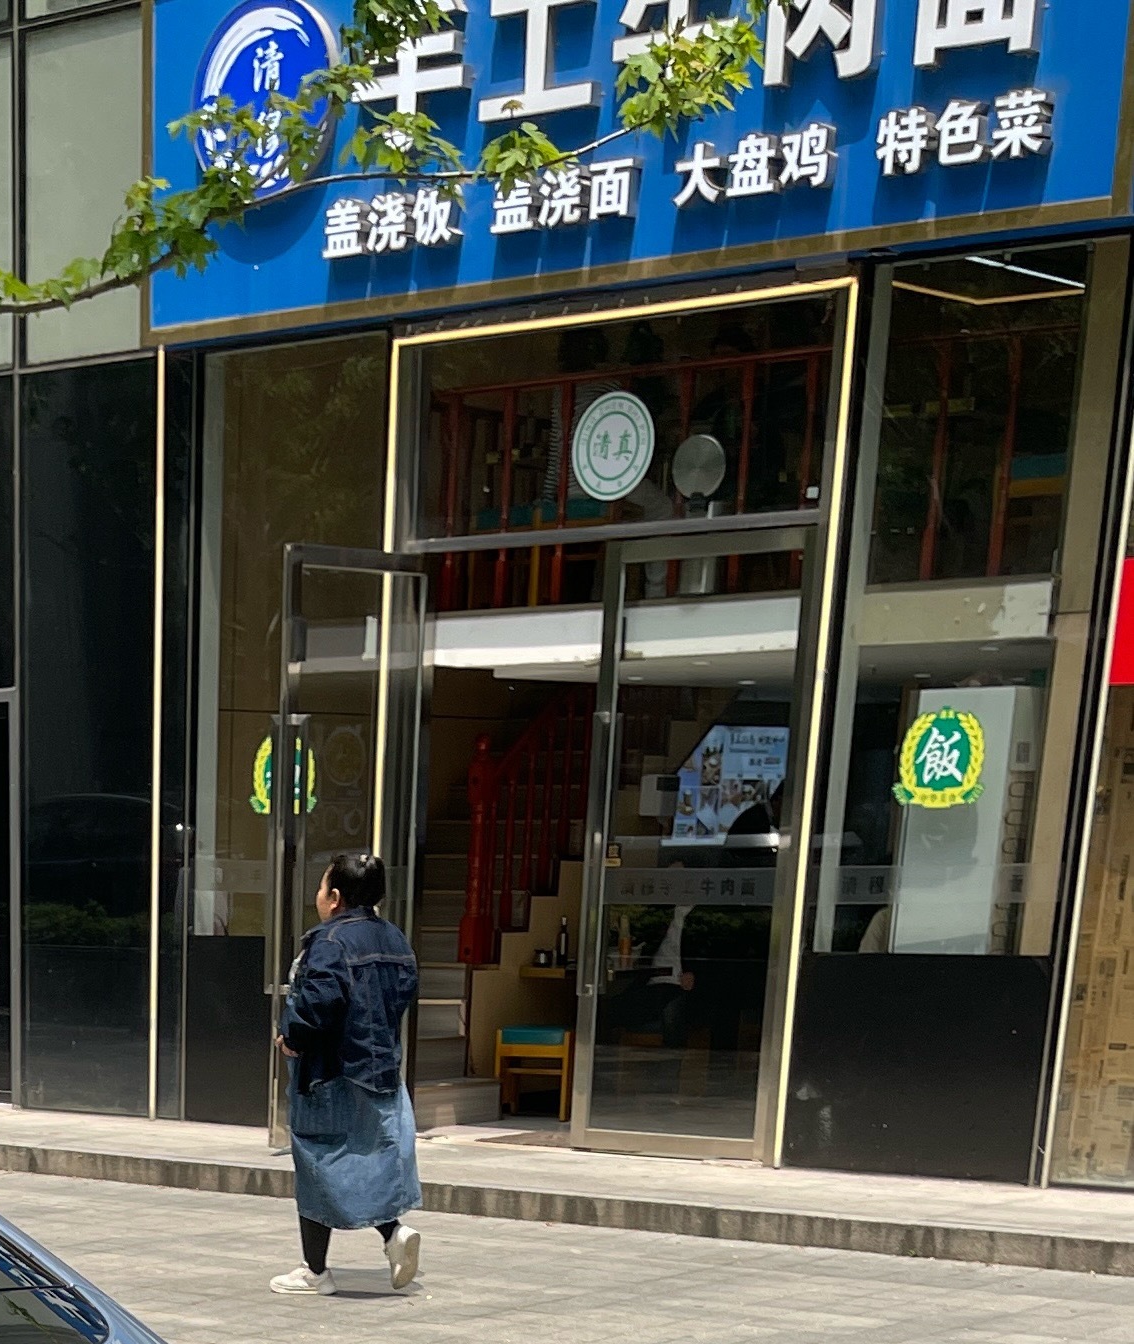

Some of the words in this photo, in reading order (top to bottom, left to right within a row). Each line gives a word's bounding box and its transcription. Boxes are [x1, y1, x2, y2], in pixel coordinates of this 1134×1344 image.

[322, 188, 463, 259] 盖浇饭
[490, 158, 633, 234] 盖浇面
[672, 123, 838, 207] 大盘鸡
[875, 89, 1047, 177] 特色菜
[593, 429, 633, 461] 清真
[915, 726, 963, 785] 飯
